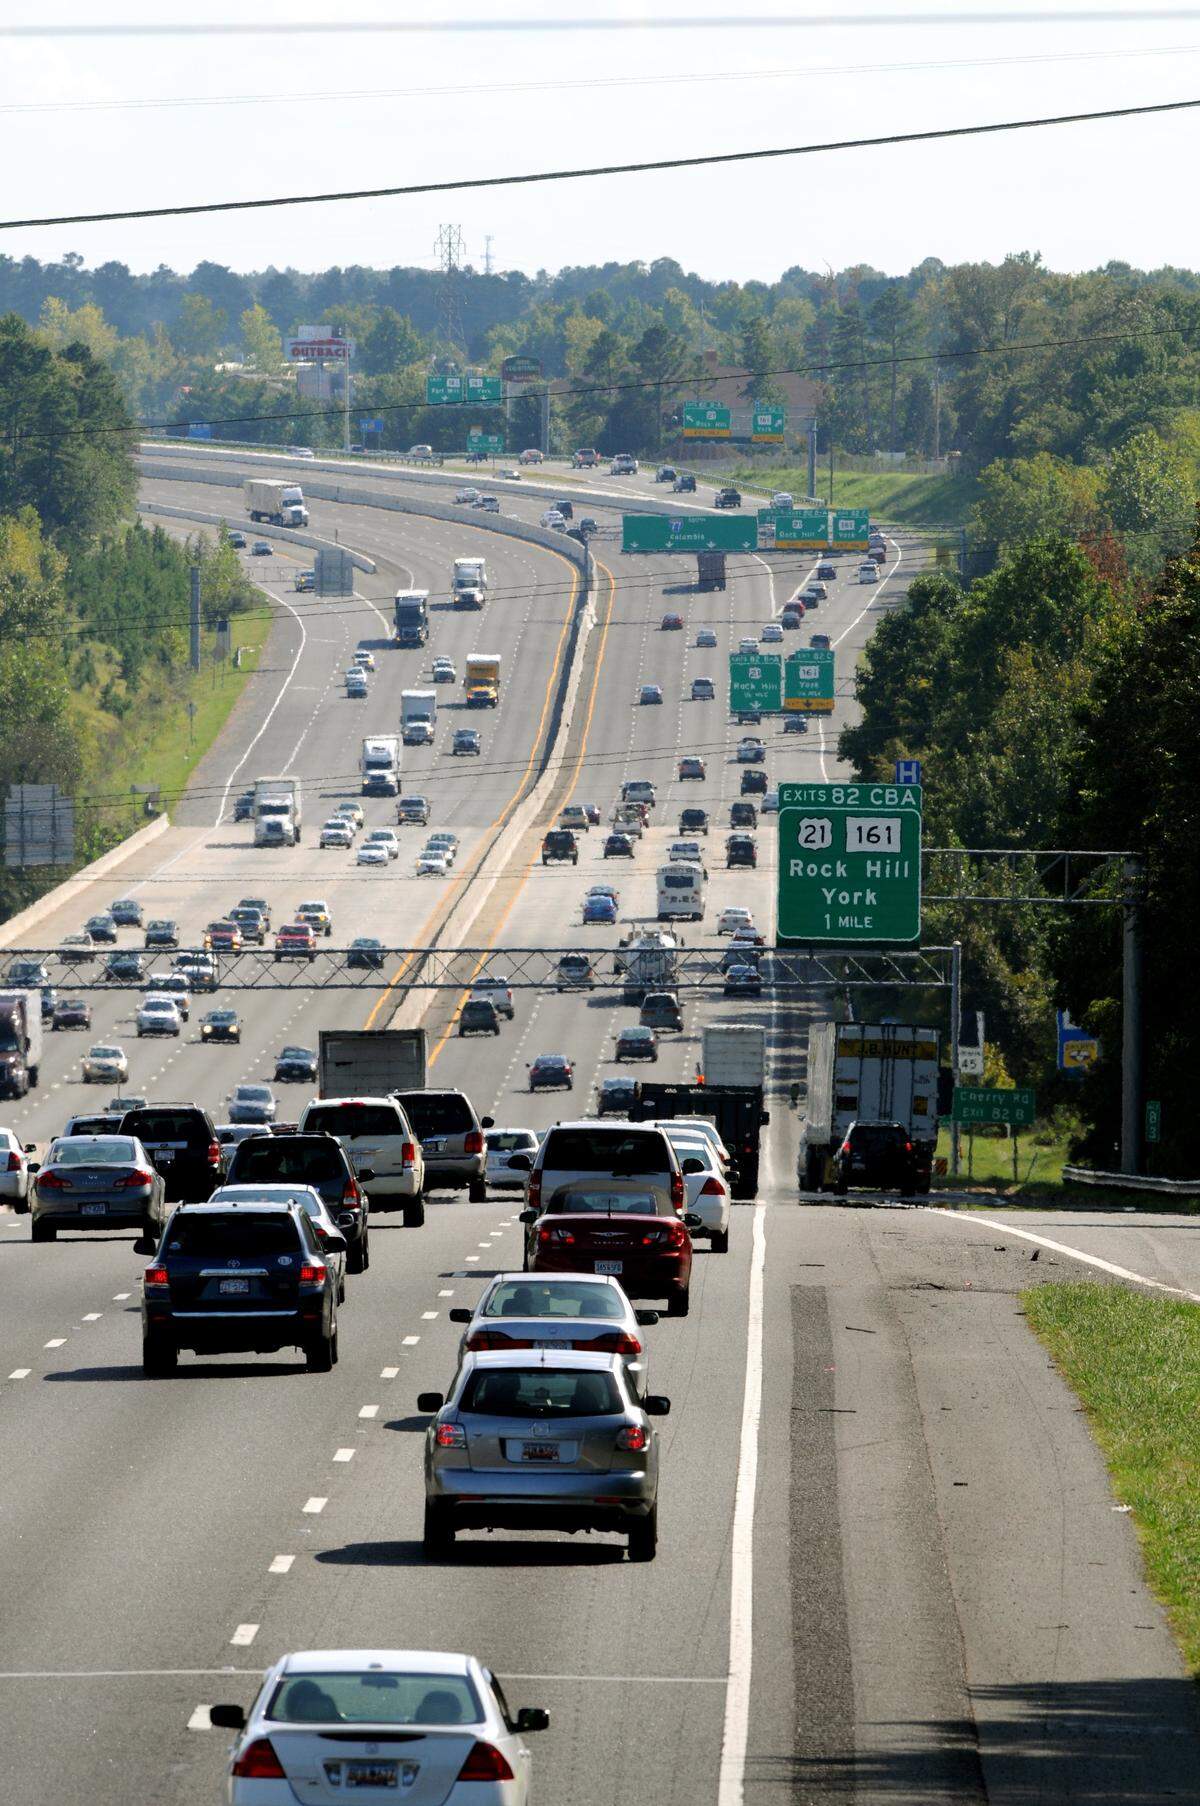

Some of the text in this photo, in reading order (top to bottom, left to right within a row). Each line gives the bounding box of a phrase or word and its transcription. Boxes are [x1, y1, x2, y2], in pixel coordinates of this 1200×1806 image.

[802, 668, 818, 677] 161
[900, 762, 916, 784] H
[783, 788, 916, 806] EXITS 82 CBA
[803, 824, 826, 844] 21
[856, 825, 892, 844] 161
[789, 858, 910, 878] Rock Hill
[821, 887, 878, 905] York
[824, 913, 873, 930] 1 MILE
[883, 1043, 918, 1056] HUNT
[962, 1058, 977, 1070] 45
[960, 1091, 1030, 1104] Cherry Rd
[962, 1107, 1025, 1120] EXIT 82 B
